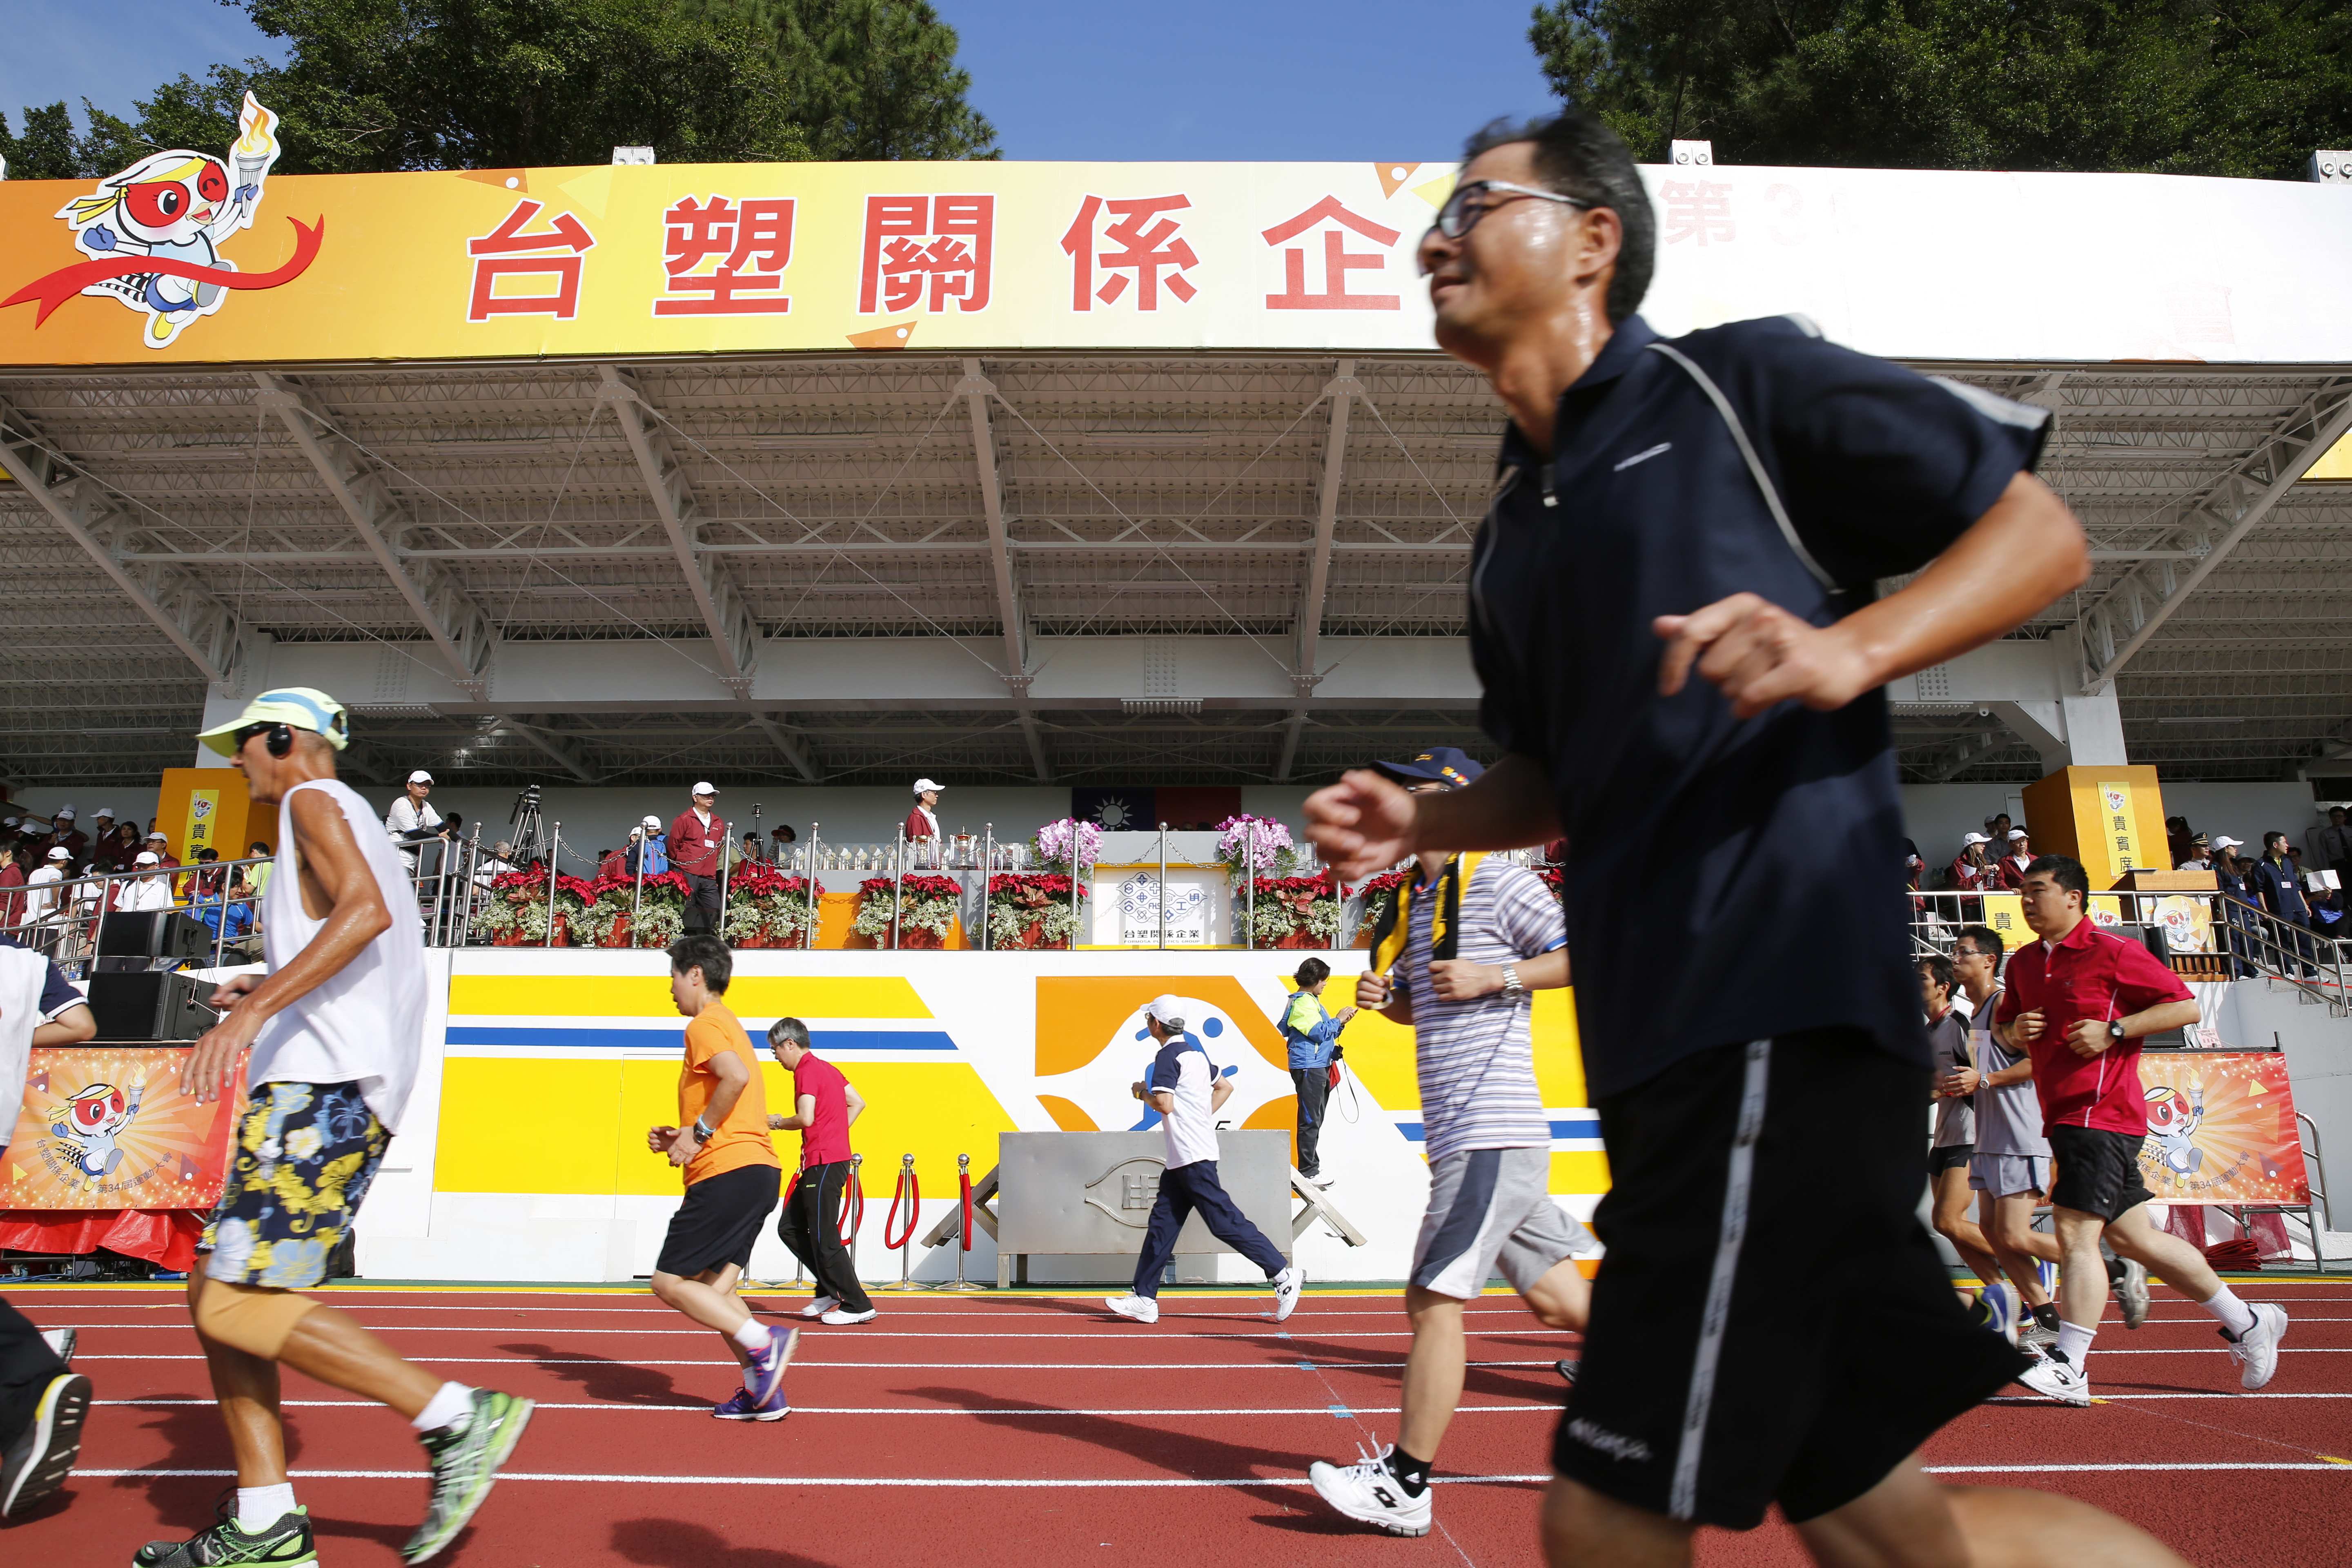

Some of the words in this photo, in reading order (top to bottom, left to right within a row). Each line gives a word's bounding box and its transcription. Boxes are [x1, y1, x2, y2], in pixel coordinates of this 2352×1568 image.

[186, 824, 206, 880] 貴賓
[2113, 815, 2133, 871] 貴賓席
[1993, 912, 2013, 930] 貴
[36, 1138, 80, 1189] 台塑關係企業
[97, 1152, 172, 1194] 第34屆運動大會
[2189, 1150, 2250, 1190] 第34屆運動大會
